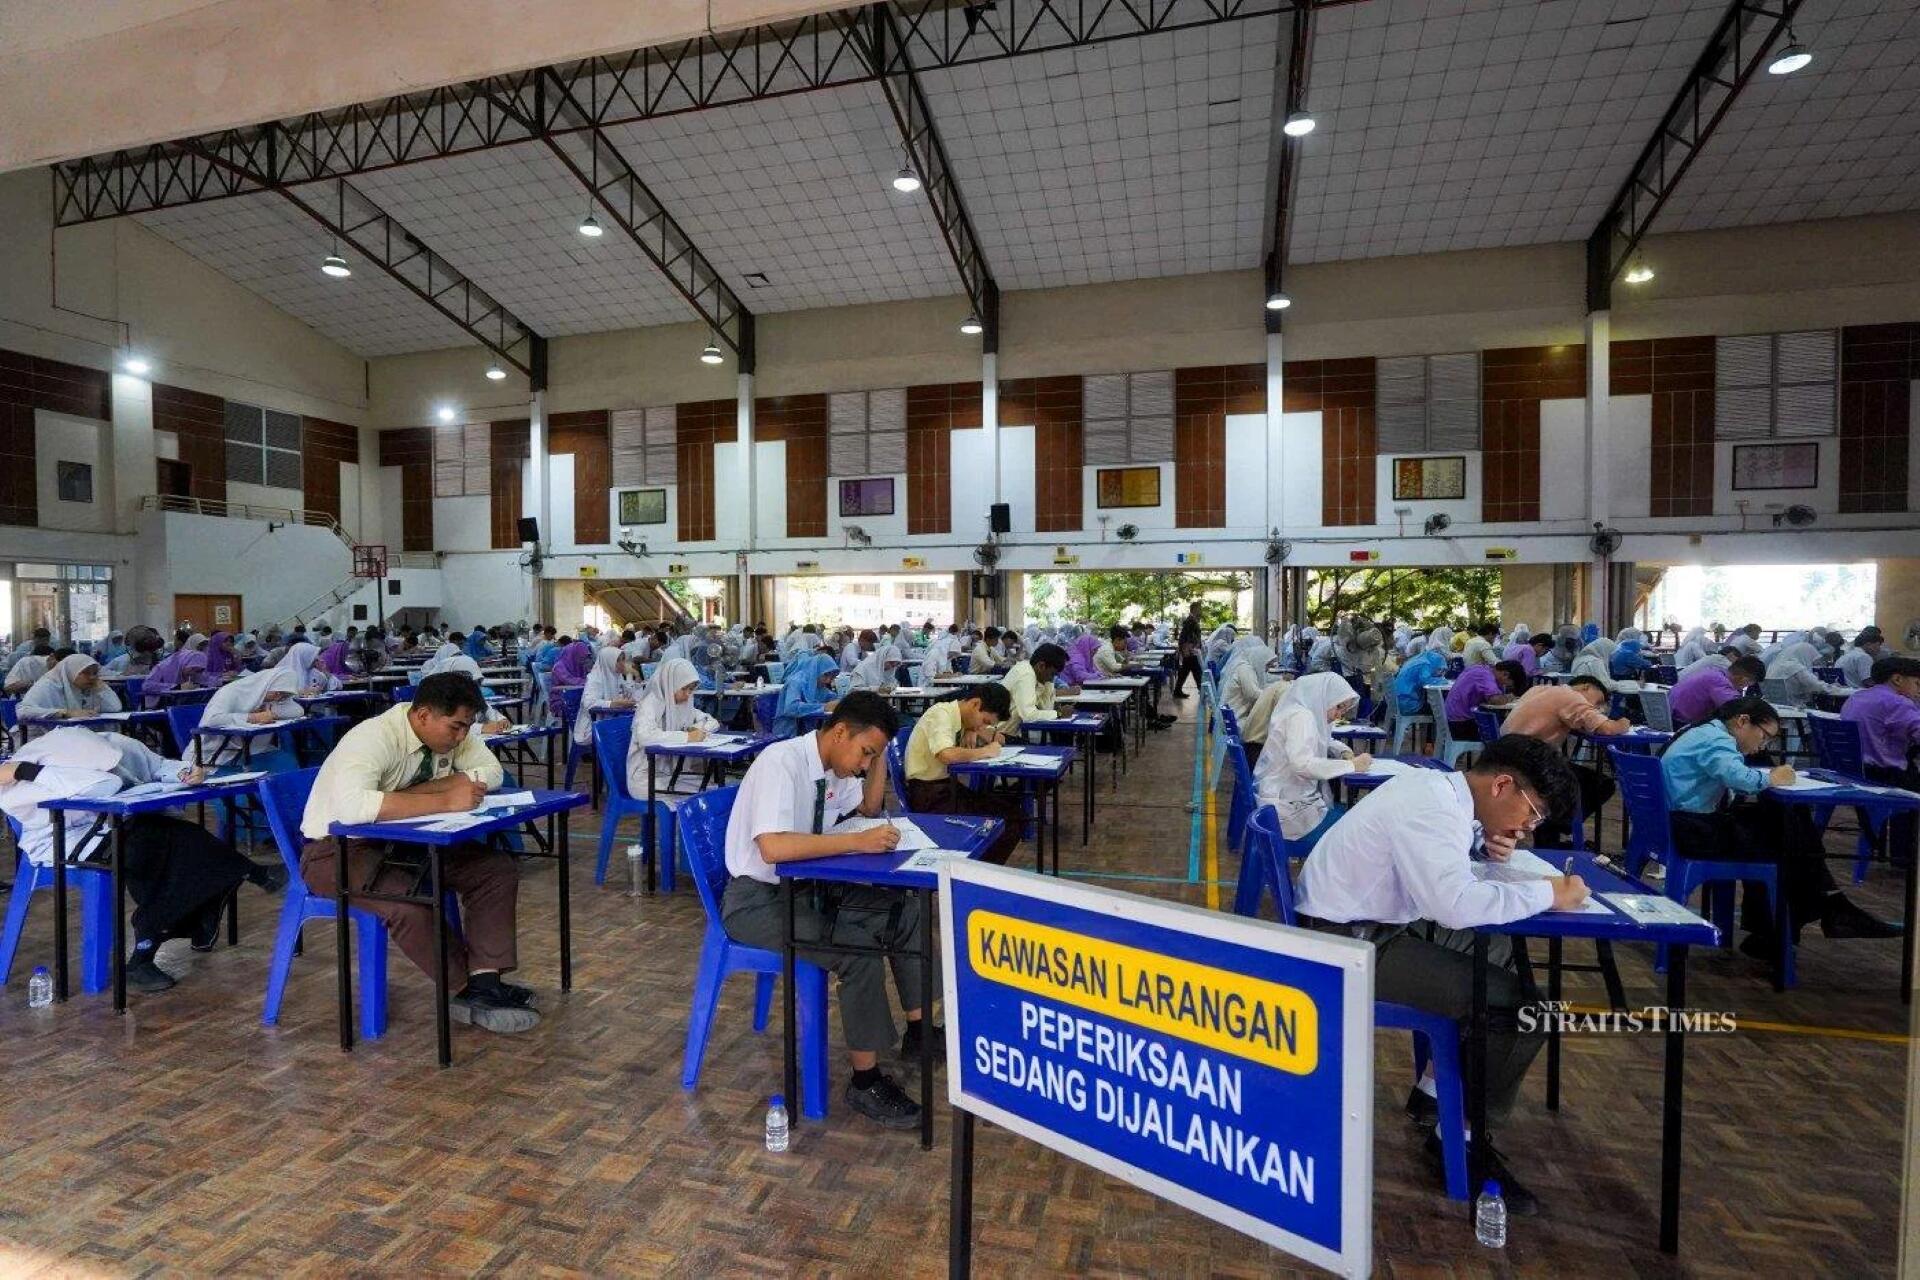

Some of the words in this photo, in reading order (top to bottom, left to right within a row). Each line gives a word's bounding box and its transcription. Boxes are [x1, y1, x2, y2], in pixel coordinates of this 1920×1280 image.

[980, 927, 1107, 999] KAWASAN
[1117, 964, 1297, 1056] LARANGAN
[975, 1036, 1087, 1112] SEDANG
[1096, 1077, 1315, 1205] DIJALANKAN
[1021, 1001, 1242, 1115] PEPERIKSAAN
